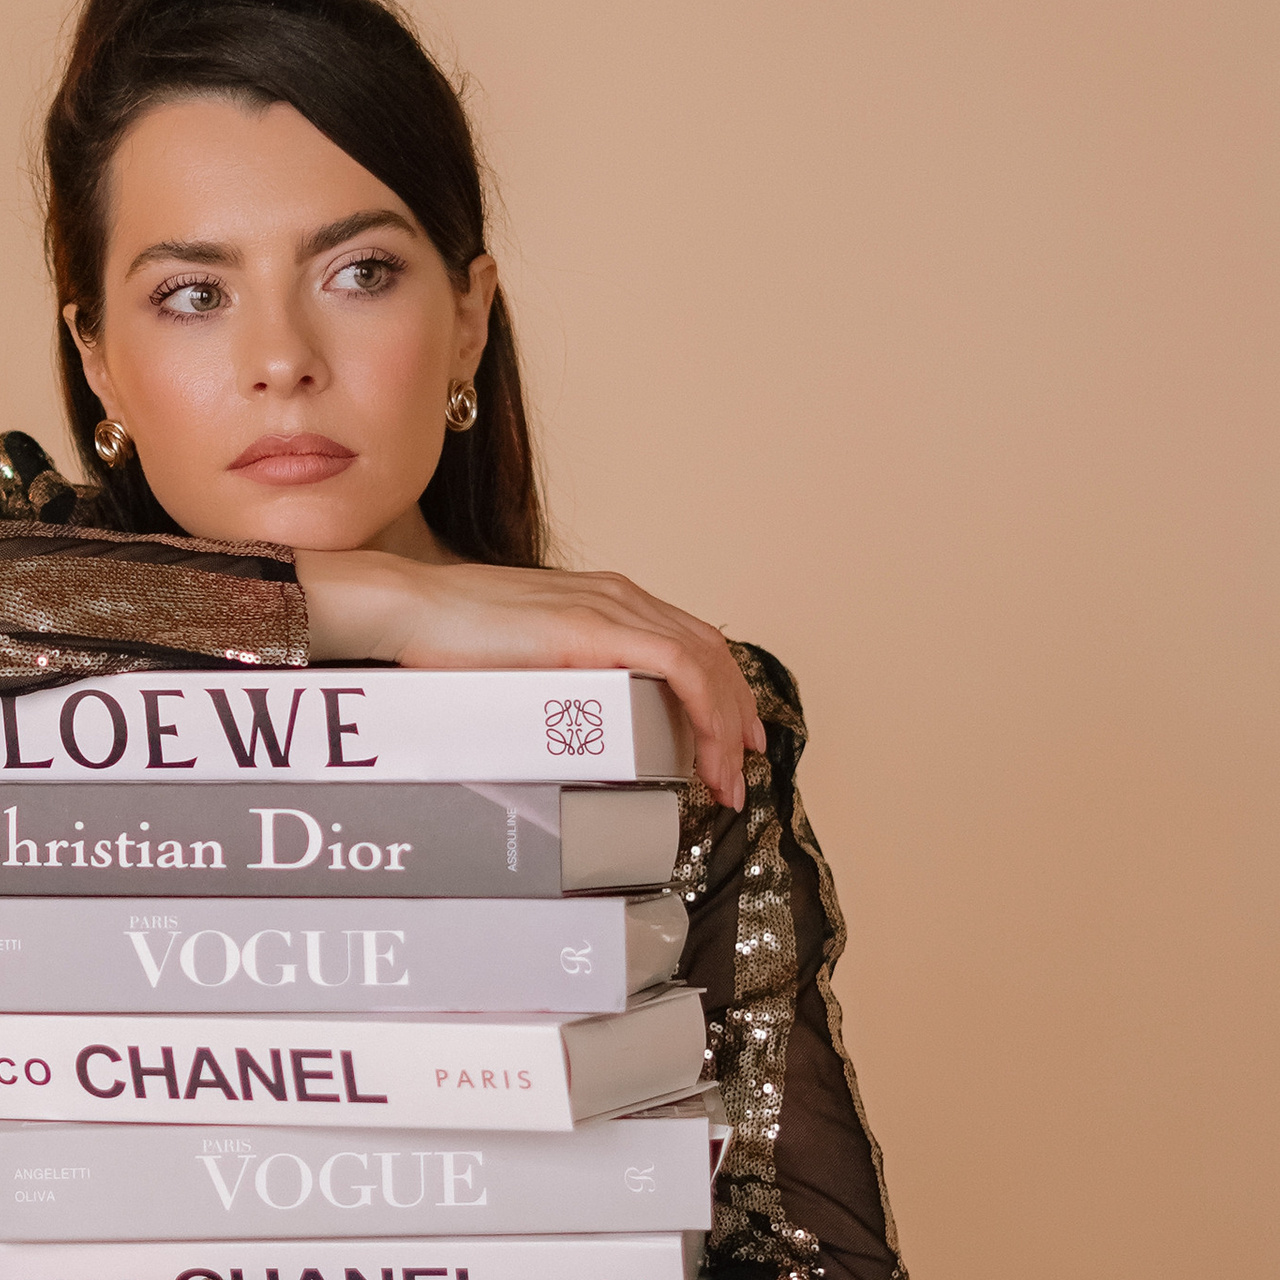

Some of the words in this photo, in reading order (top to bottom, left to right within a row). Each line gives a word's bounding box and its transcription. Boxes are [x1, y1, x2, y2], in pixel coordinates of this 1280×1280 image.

[0, 687, 380, 770] LOEWE
[246, 807, 412, 871] Dior
[506, 806, 518, 873] ASSOULINE
[128, 915, 179, 929] PARIS
[122, 928, 410, 989] VOGUE
[75, 1043, 389, 1104] CHANEL
[434, 1068, 532, 1090] PARIS
[13, 1166, 91, 1181] ANGELETTI
[202, 1138, 253, 1153] PARIS
[14, 1189, 56, 1203] OLIVA
[194, 1151, 488, 1211] VOGUE
